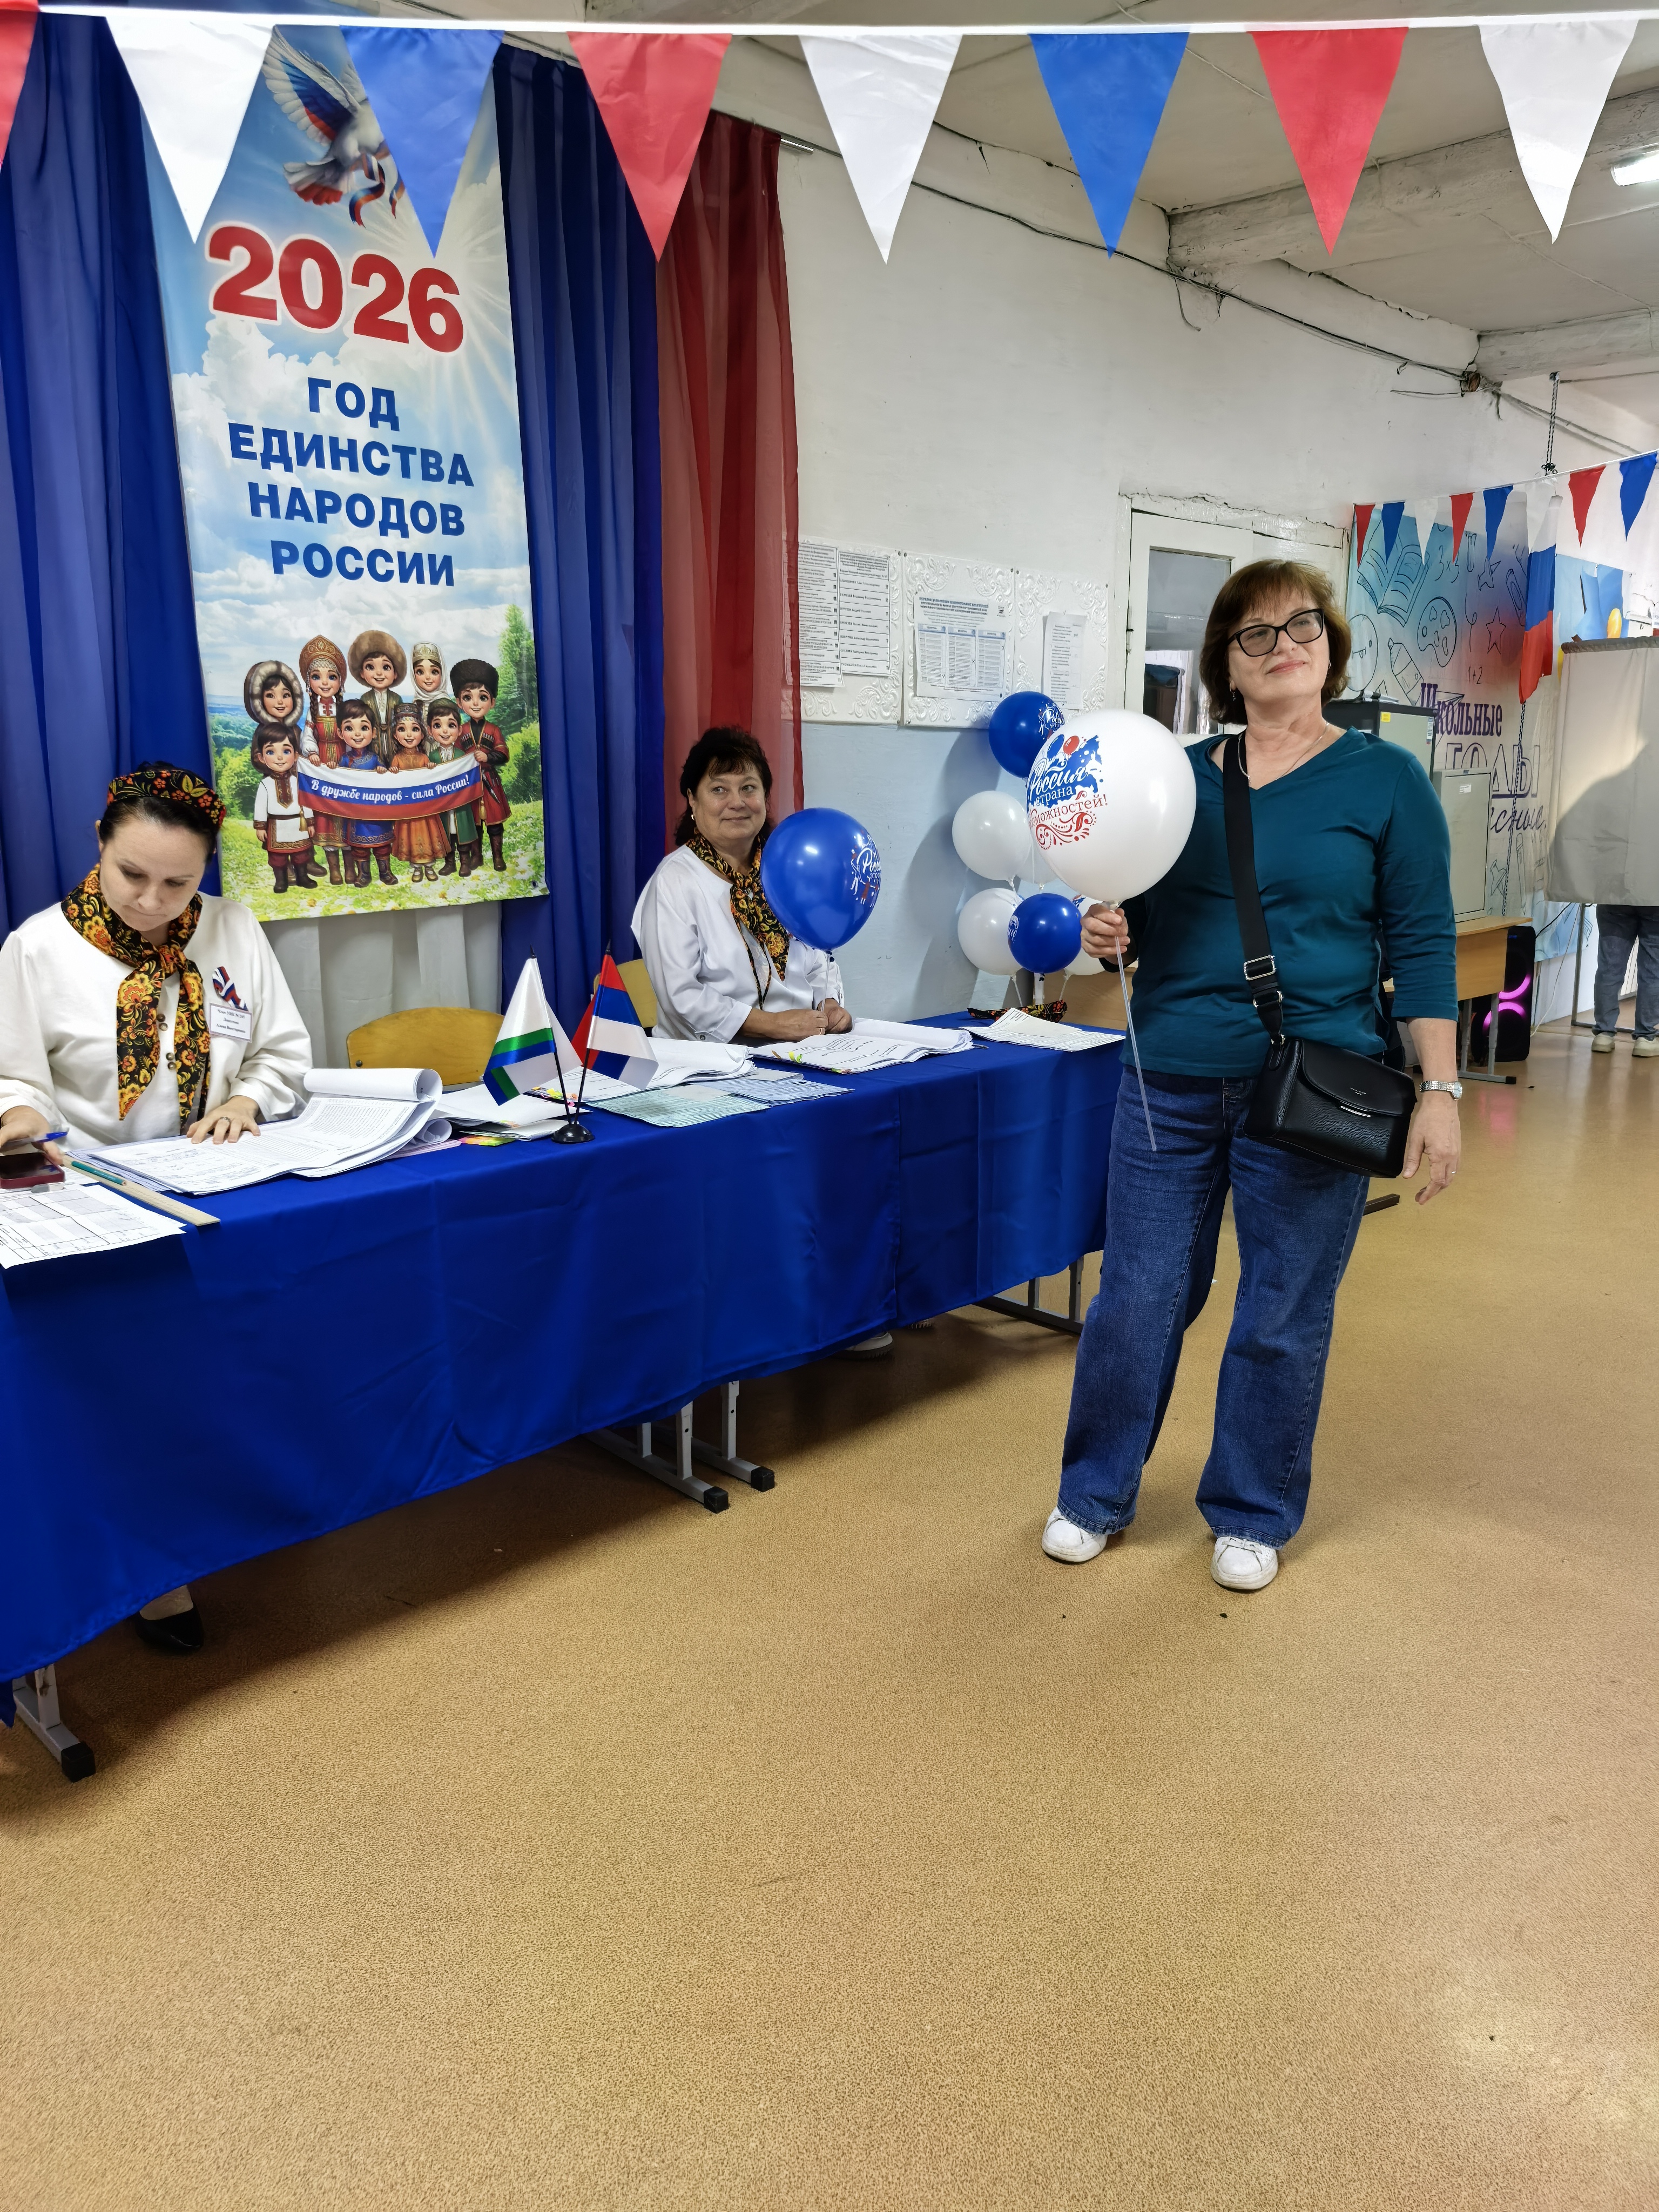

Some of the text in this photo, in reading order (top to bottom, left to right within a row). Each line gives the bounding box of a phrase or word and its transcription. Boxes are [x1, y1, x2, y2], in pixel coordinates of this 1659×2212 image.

[209, 225, 464, 353] 2026
[308, 377, 400, 431] ГОД
[228, 422, 474, 487] ЕДИНСТВА
[248, 482, 465, 538] НАРОДОВ
[271, 540, 455, 587] РОССИИ
[312, 779, 319, 791] В
[321, 785, 360, 800] дружбе
[363, 790, 402, 804] народов
[412, 789, 434, 799] сила
[435, 774, 469, 794] России!
[1027, 758, 1089, 801] Россия
[1036, 786, 1074, 806] страна
[1028, 794, 1108, 828] озможностей!
[1491, 805, 1545, 833] сные
